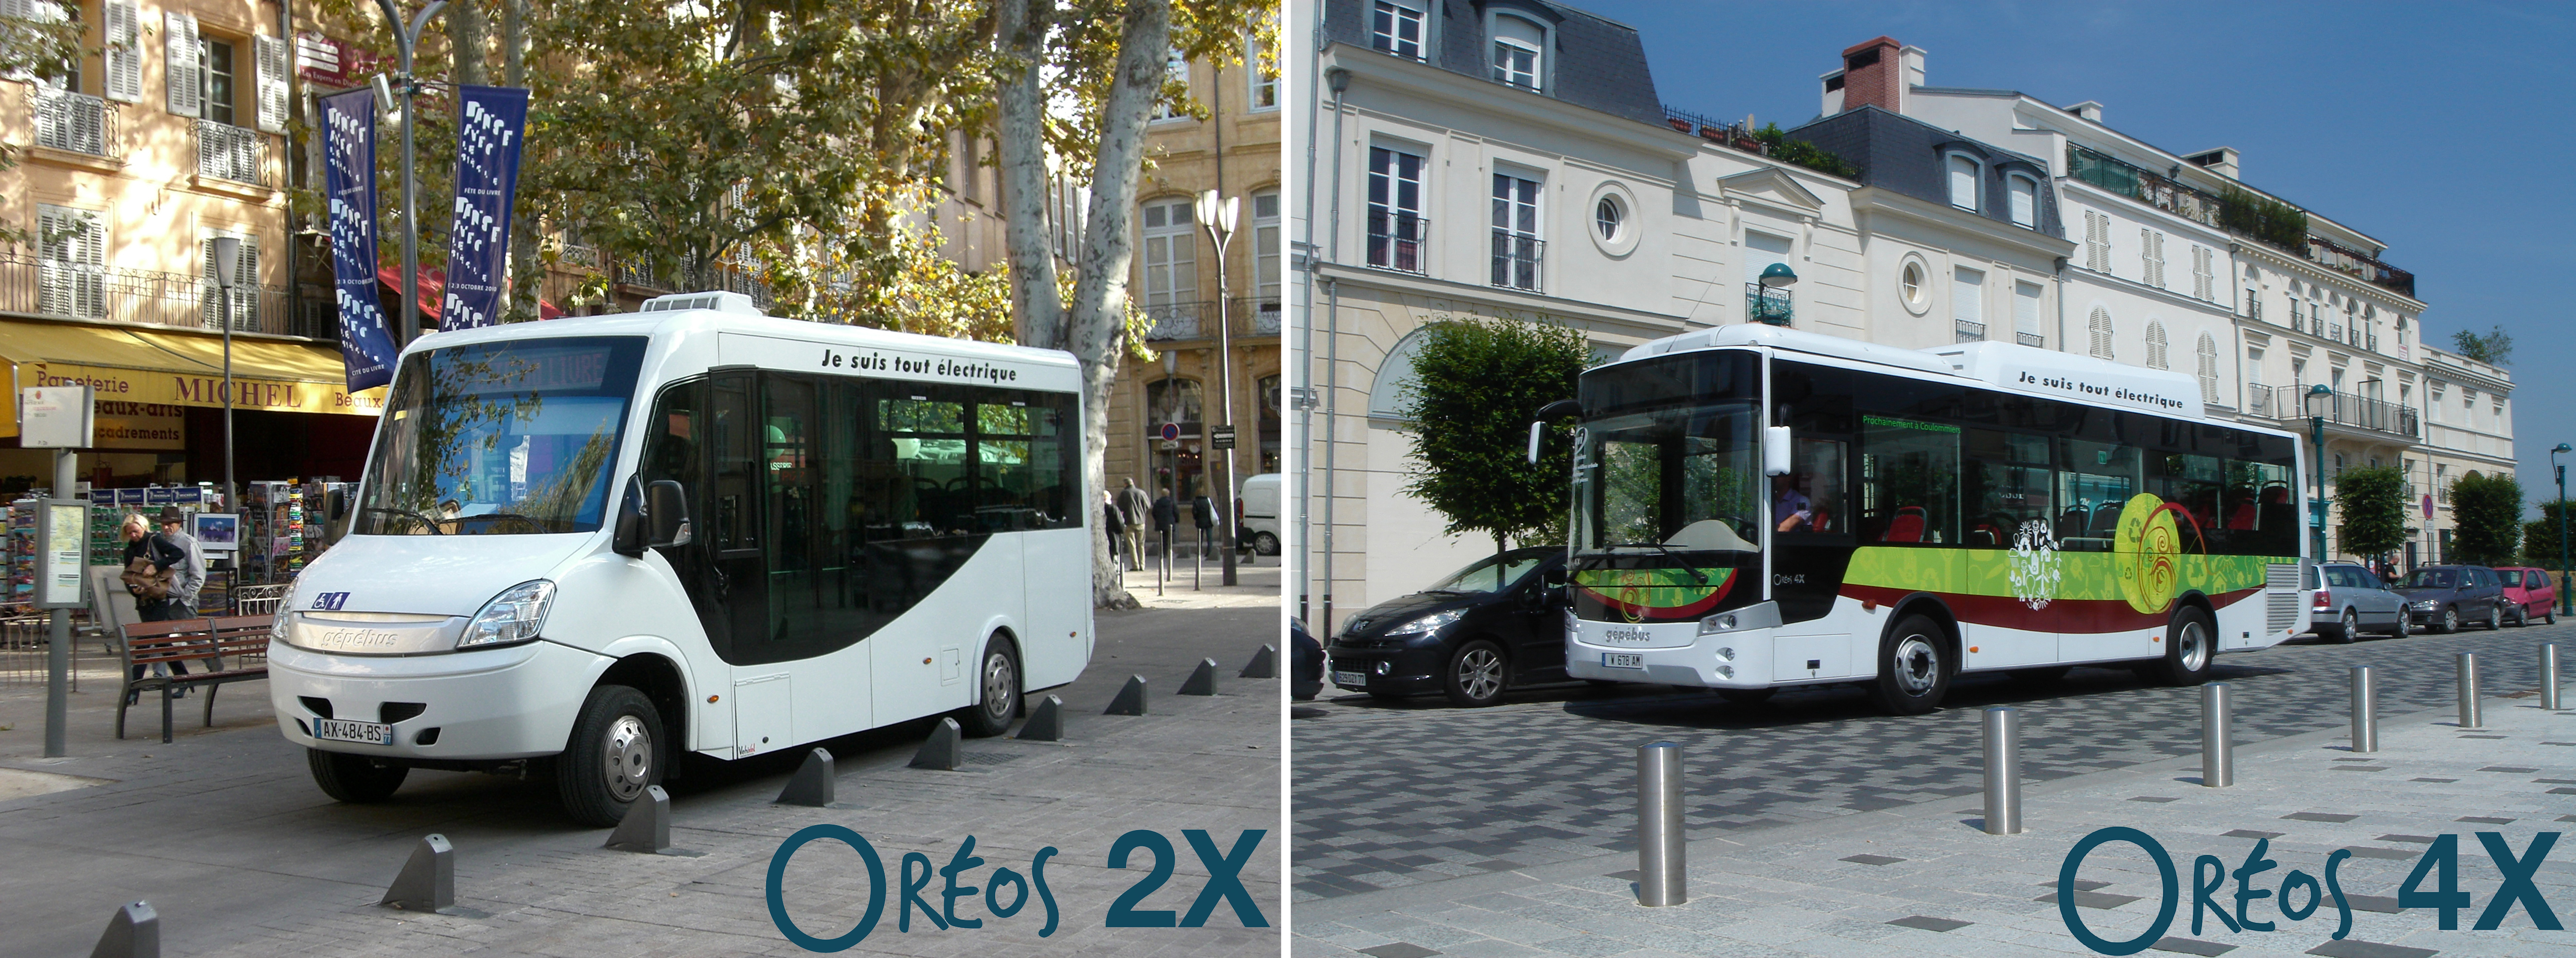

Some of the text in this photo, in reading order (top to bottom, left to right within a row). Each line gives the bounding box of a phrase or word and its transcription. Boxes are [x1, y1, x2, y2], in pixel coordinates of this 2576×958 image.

[447, 293, 487, 328] DANS
[549, 354, 603, 386] LIVRE
[821, 349, 1017, 384] Je suis tout électrique
[174, 376, 301, 408] MICHEL
[2019, 371, 2183, 409] Je suis tout électrique
[1863, 416, 1913, 429] Prochainement
[1920, 422, 1961, 434] Coulommiers
[1795, 574, 1805, 584] 4X
[321, 628, 398, 650] gépébus
[1606, 627, 1650, 643] gépébus
[1618, 655, 1629, 666] 678
[1632, 656, 1640, 666] AM
[384, 735, 391, 743] 77
